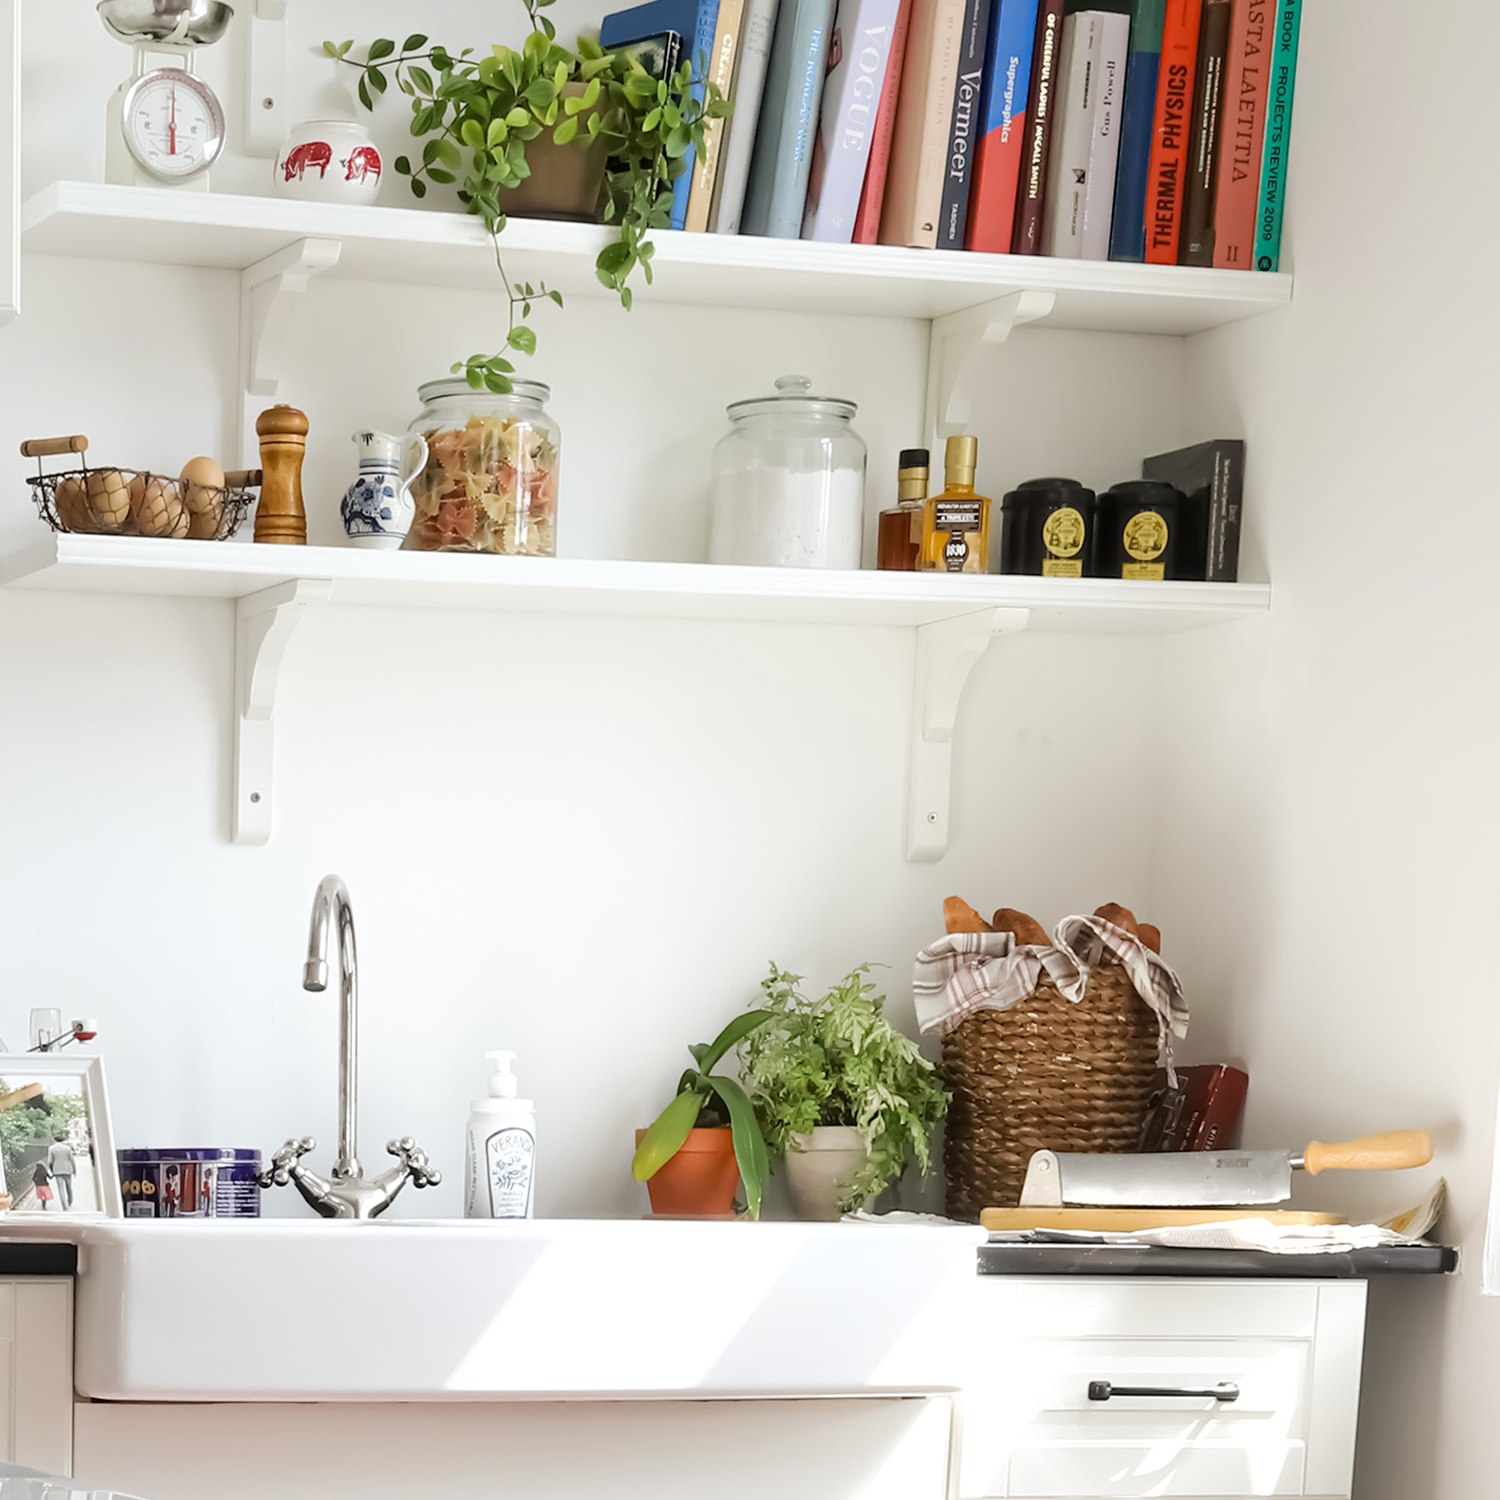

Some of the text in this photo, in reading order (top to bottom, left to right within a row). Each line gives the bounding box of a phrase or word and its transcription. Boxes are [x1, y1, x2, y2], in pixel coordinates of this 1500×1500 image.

[1047, 13, 1056, 29] OF
[1281, 11, 1294, 52] BOOK
[1041, 29, 1055, 81] CHEERFUL
[843, 25, 887, 150] VOGUE
[1001, 56, 1019, 143] Supergraphics
[1037, 80, 1049, 118] LADIES
[1100, 60, 1116, 137] Gus Powell
[1204, 73, 1213, 110] BUSINESS
[1271, 66, 1288, 143] PROJECTS
[950, 68, 982, 183] Vermeer
[1232, 66, 1259, 183] LAETITIA
[1029, 165, 1040, 199] SMITH
[1153, 64, 1188, 248] THERMAL PHYSICS
[1266, 146, 1281, 204] REVIEW
[949, 203, 958, 240] TASCHEN
[1262, 206, 1274, 241] 2009
